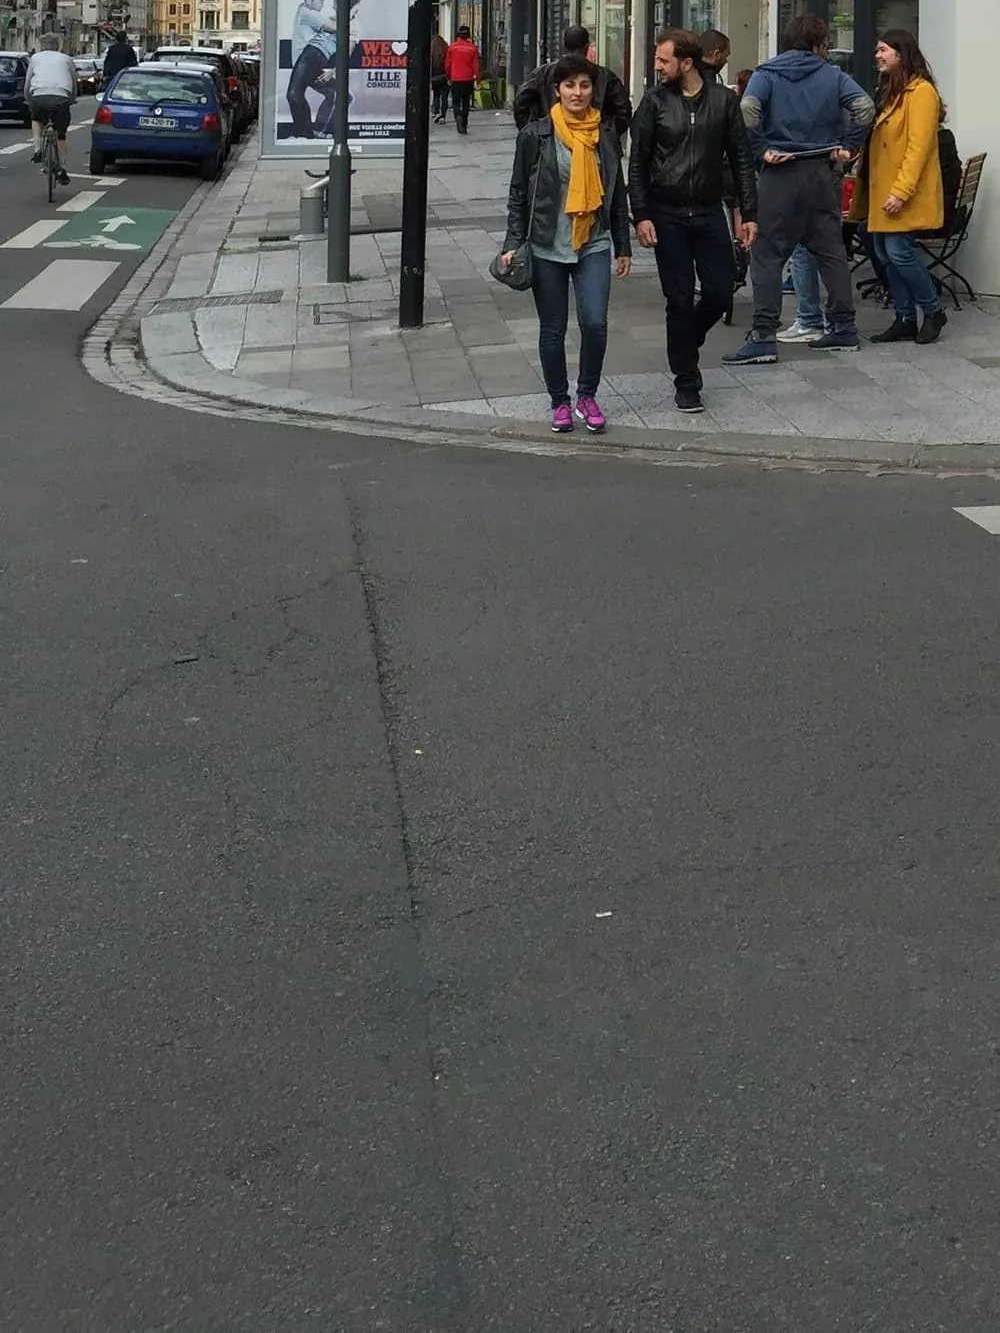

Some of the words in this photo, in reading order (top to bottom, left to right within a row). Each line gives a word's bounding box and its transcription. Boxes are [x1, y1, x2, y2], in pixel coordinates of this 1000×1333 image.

[361, 41, 391, 56] WE
[362, 56, 408, 67] DENIM
[367, 71, 401, 81] LILLE
[366, 81, 401, 89] COMEDIE
